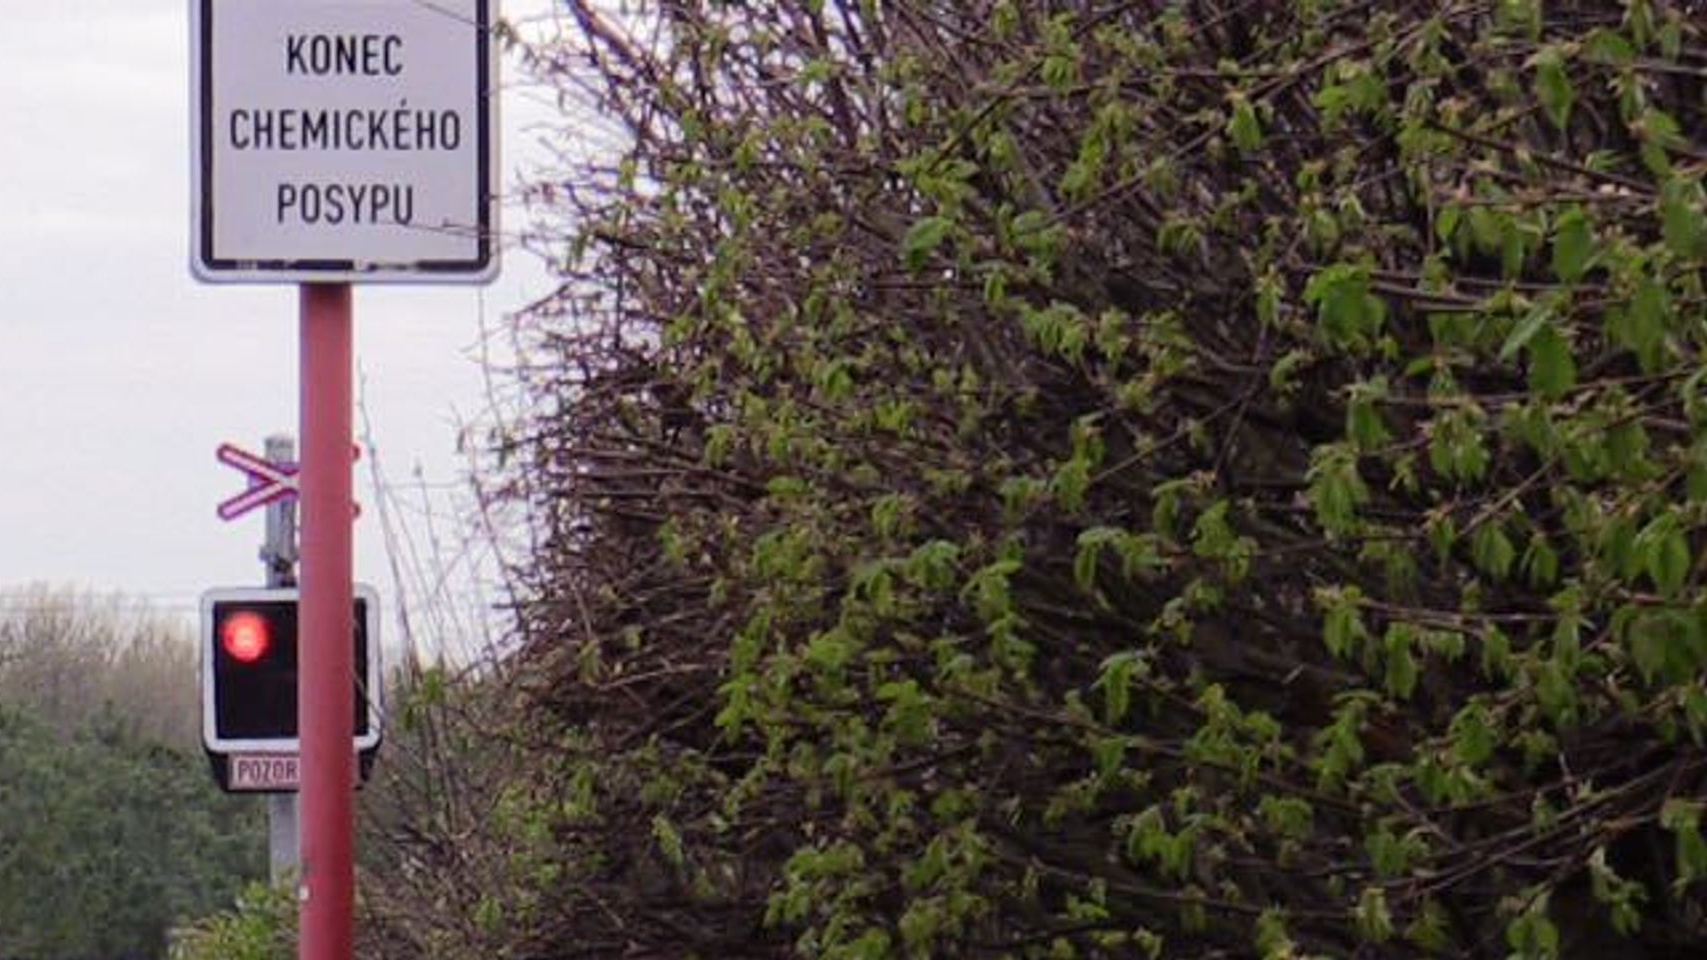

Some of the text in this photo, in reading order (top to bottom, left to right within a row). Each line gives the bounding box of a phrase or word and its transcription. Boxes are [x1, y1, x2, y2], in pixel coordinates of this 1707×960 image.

[287, 34, 403, 76] KONEC
[229, 97, 461, 151] CHEMICKÉHO
[277, 183, 413, 225] POSYPU
[237, 759, 298, 783] POZOR
